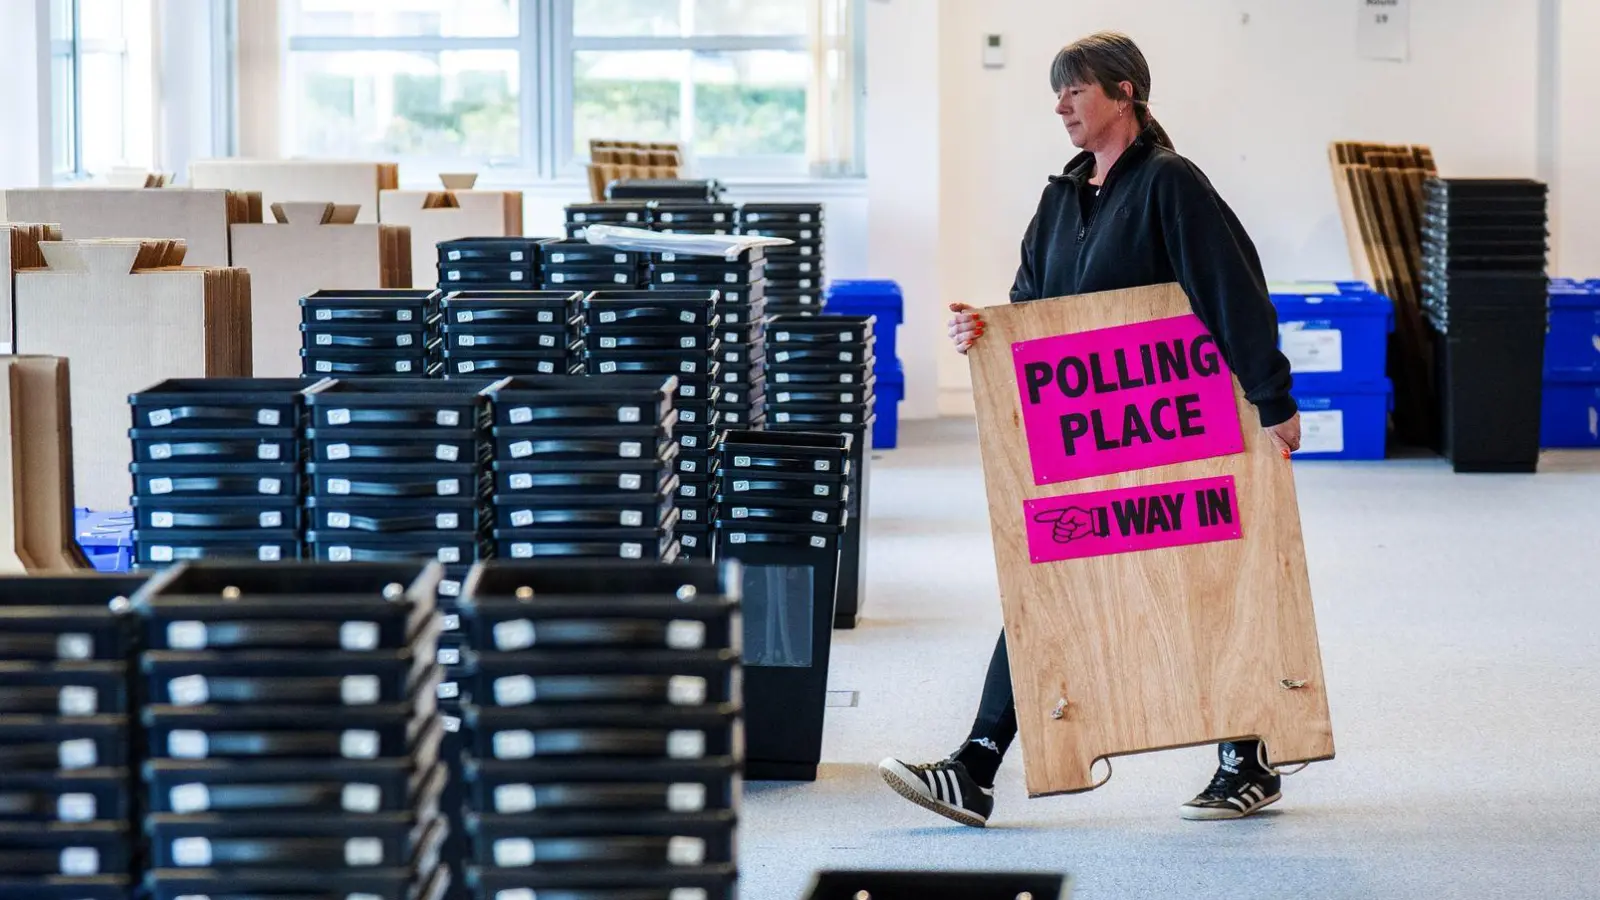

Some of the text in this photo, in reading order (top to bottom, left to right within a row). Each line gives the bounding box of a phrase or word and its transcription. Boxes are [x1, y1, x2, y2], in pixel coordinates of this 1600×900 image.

[1024, 334, 1221, 405] POLLING
[1059, 393, 1205, 456] PLACE
[1112, 487, 1233, 537] WAY IN
